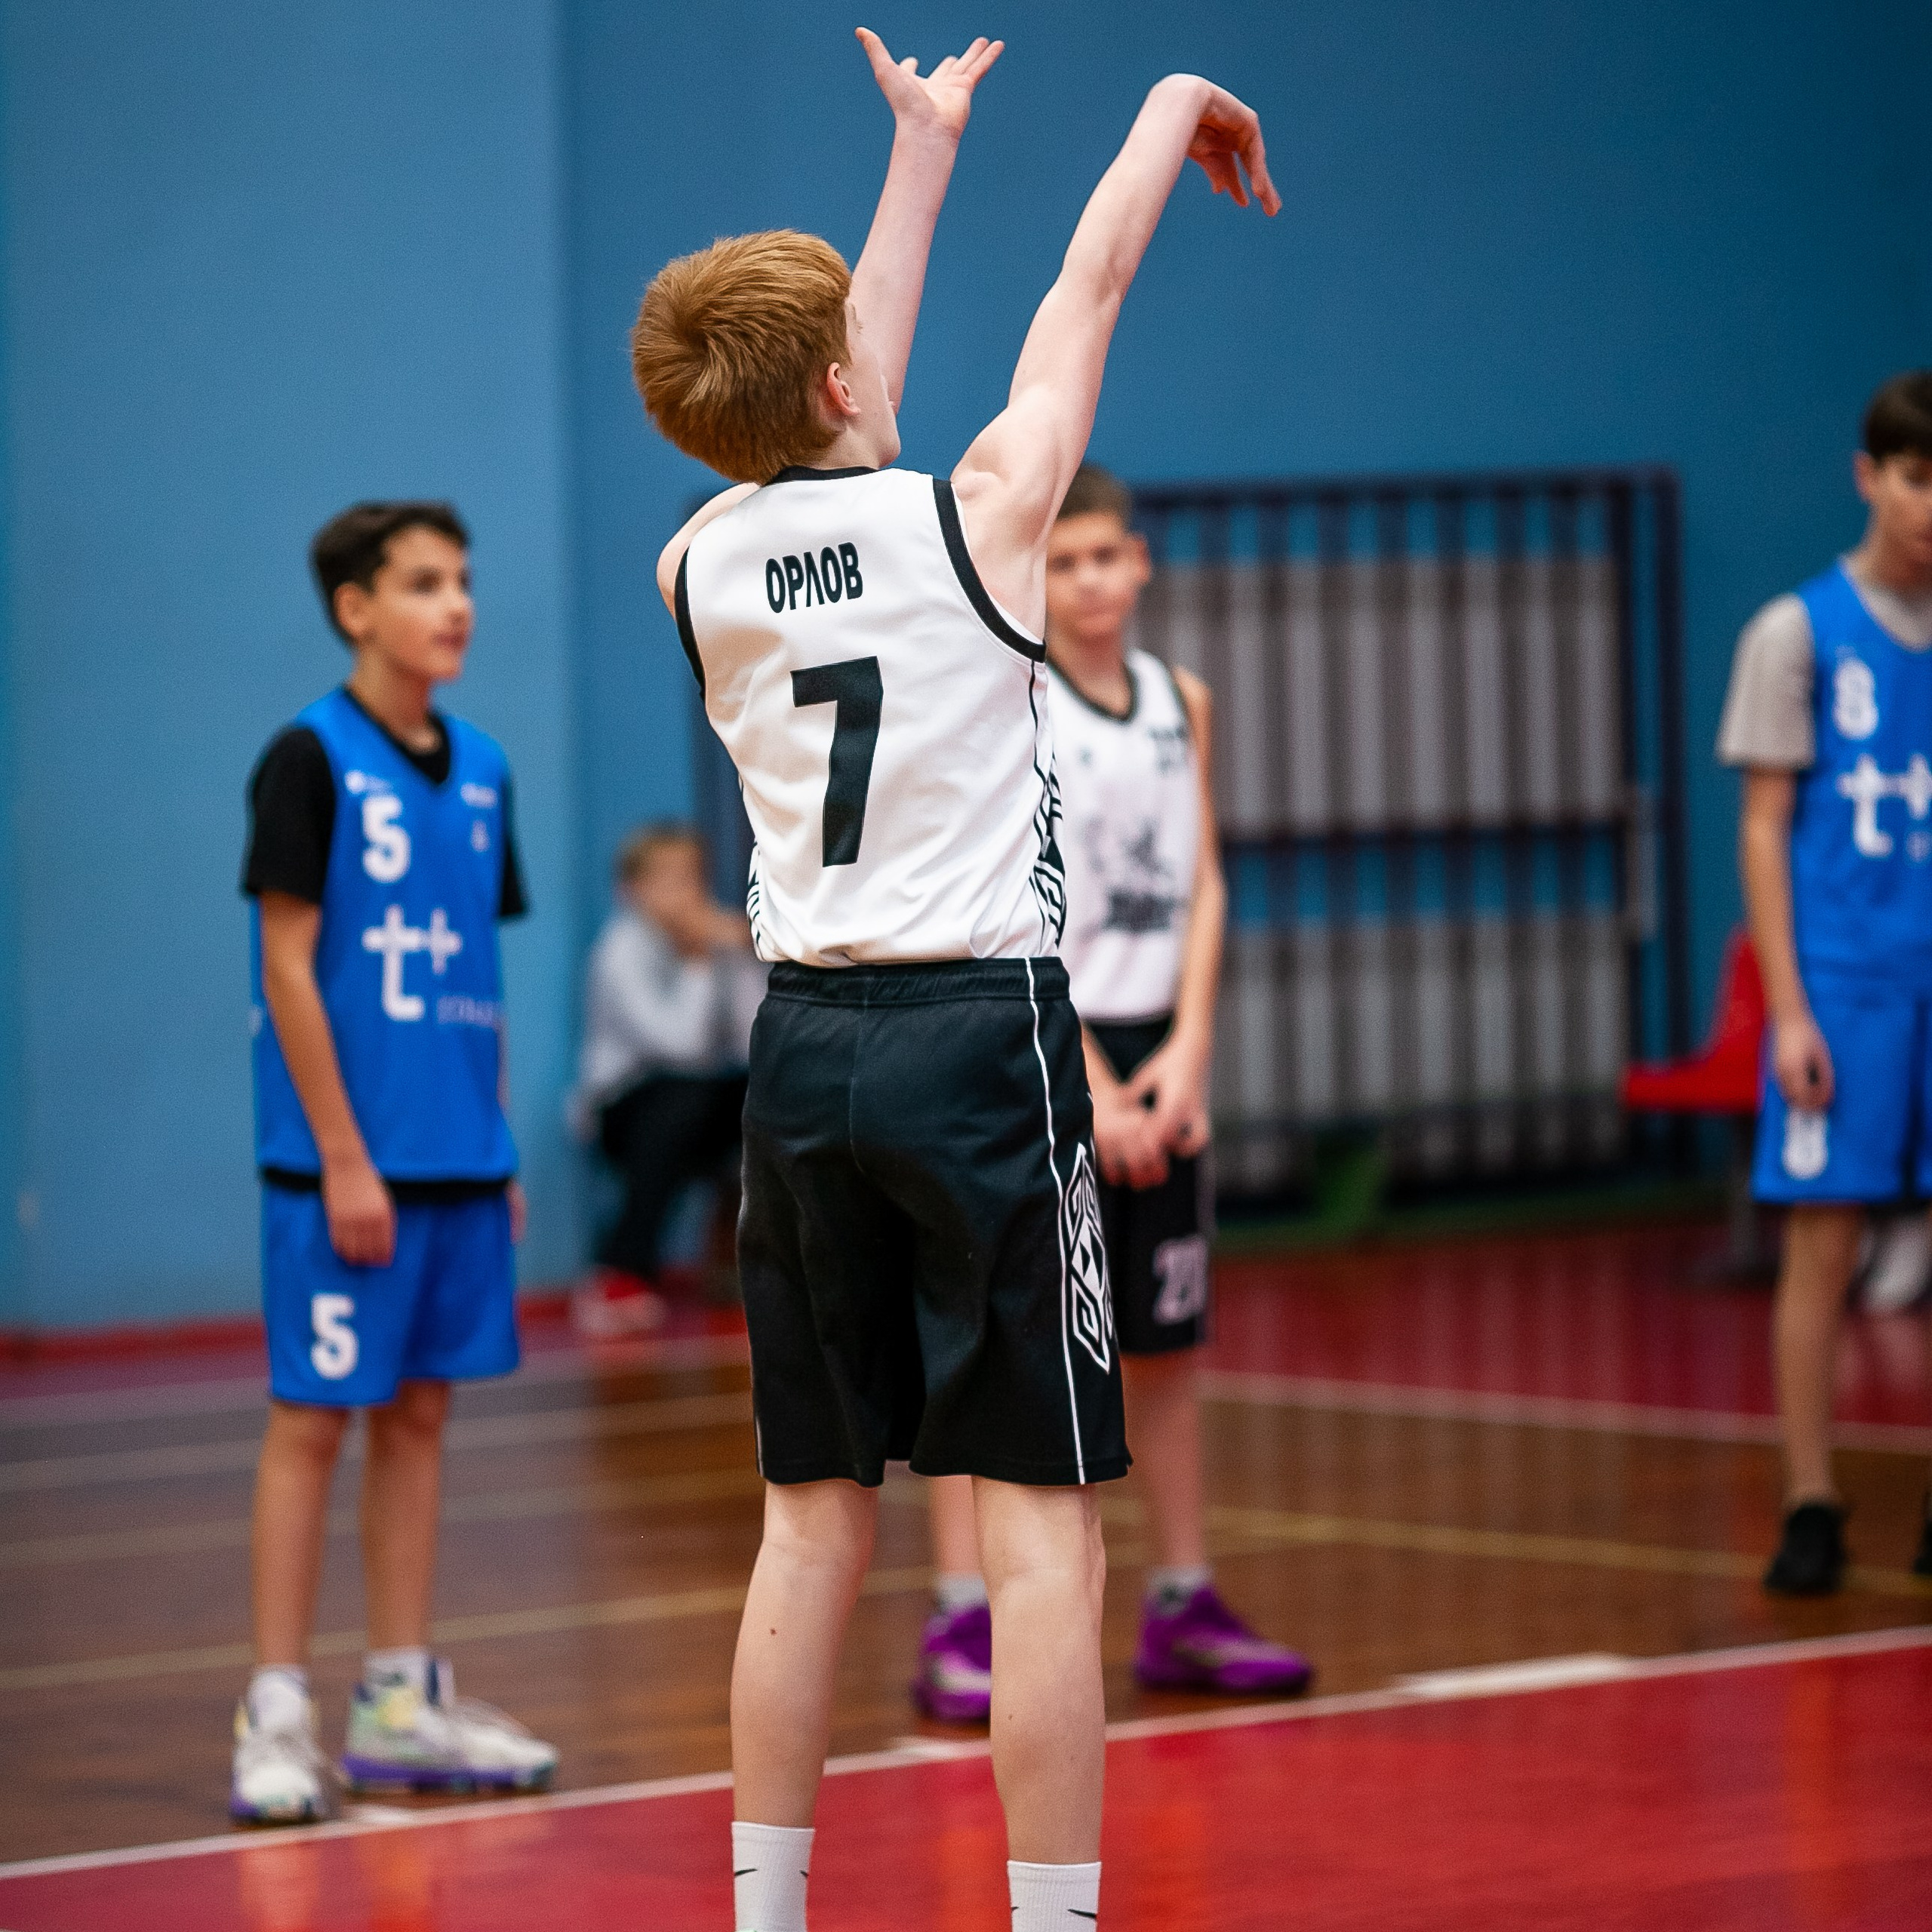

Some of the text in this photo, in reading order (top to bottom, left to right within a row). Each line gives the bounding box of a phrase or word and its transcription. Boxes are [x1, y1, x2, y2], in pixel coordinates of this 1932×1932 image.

[764, 541, 863, 614] ОРЛОВ
[789, 655, 884, 868] 7
[362, 794, 412, 883] 5
[310, 1292, 361, 1380] 5
